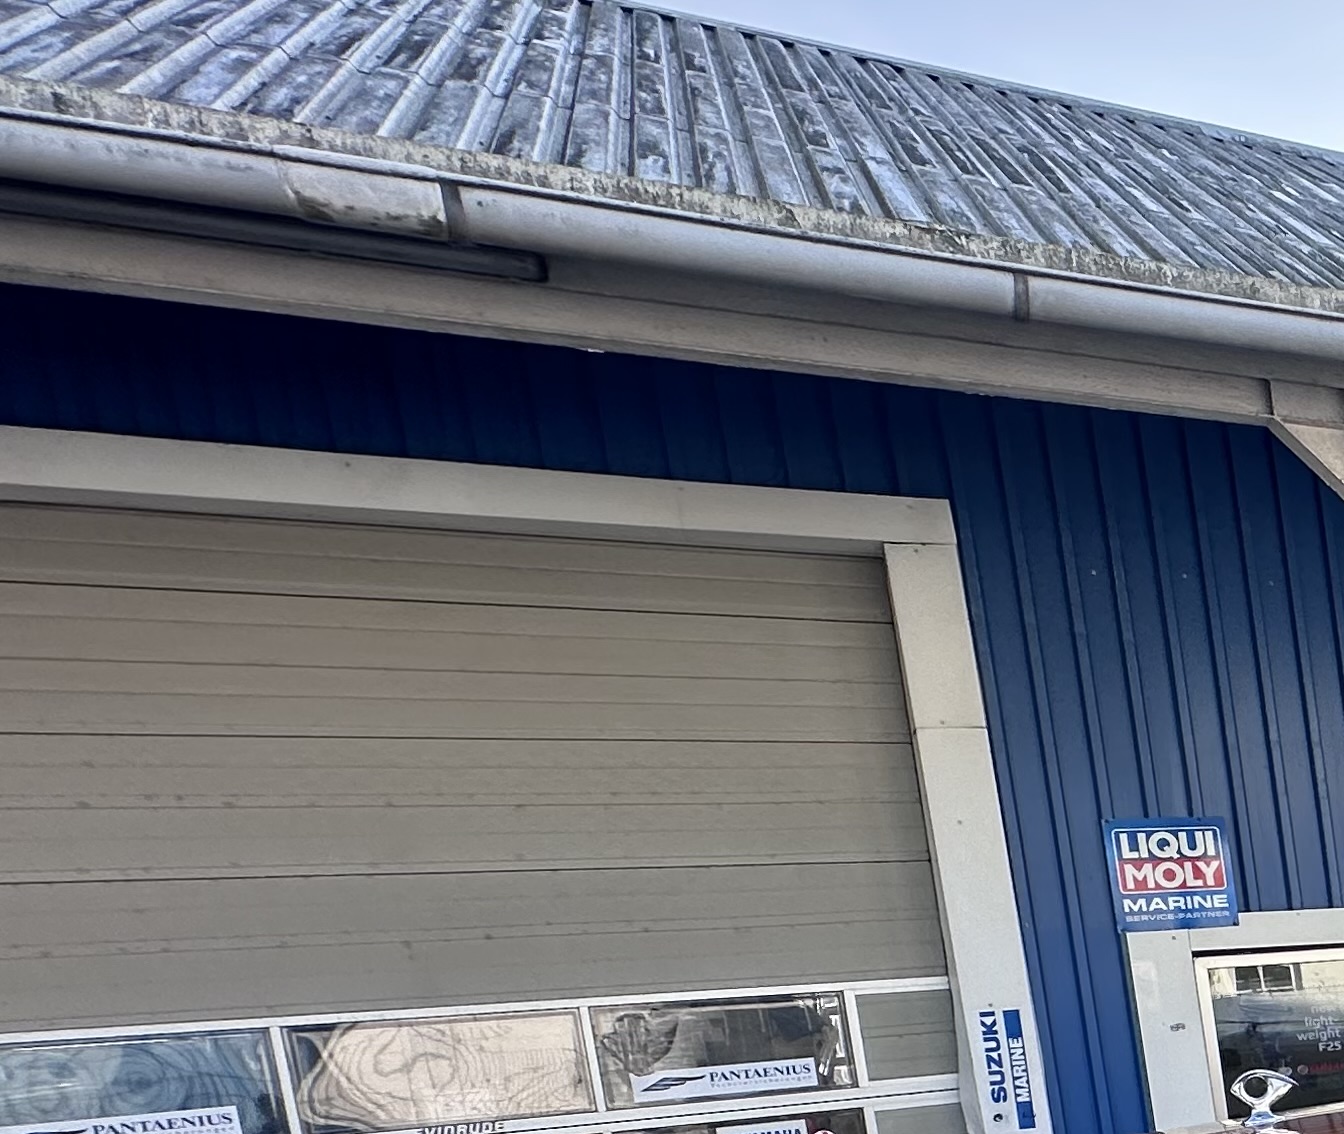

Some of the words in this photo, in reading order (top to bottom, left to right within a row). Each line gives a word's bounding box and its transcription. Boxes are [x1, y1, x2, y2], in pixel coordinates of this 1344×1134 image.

[1119, 830, 1217, 860] LIQUI
[1123, 860, 1220, 890] MOLY
[1123, 894, 1230, 913] MARINE
[1125, 910, 1231, 923] SERVICE-PARTNER
[1296, 1026, 1342, 1042] weight
[1318, 1041, 1342, 1052] F25
[979, 1010, 1008, 1104] SUZUKI
[708, 1063, 812, 1083] PANTAENIUS
[1008, 1036, 1032, 1103] MARINE
